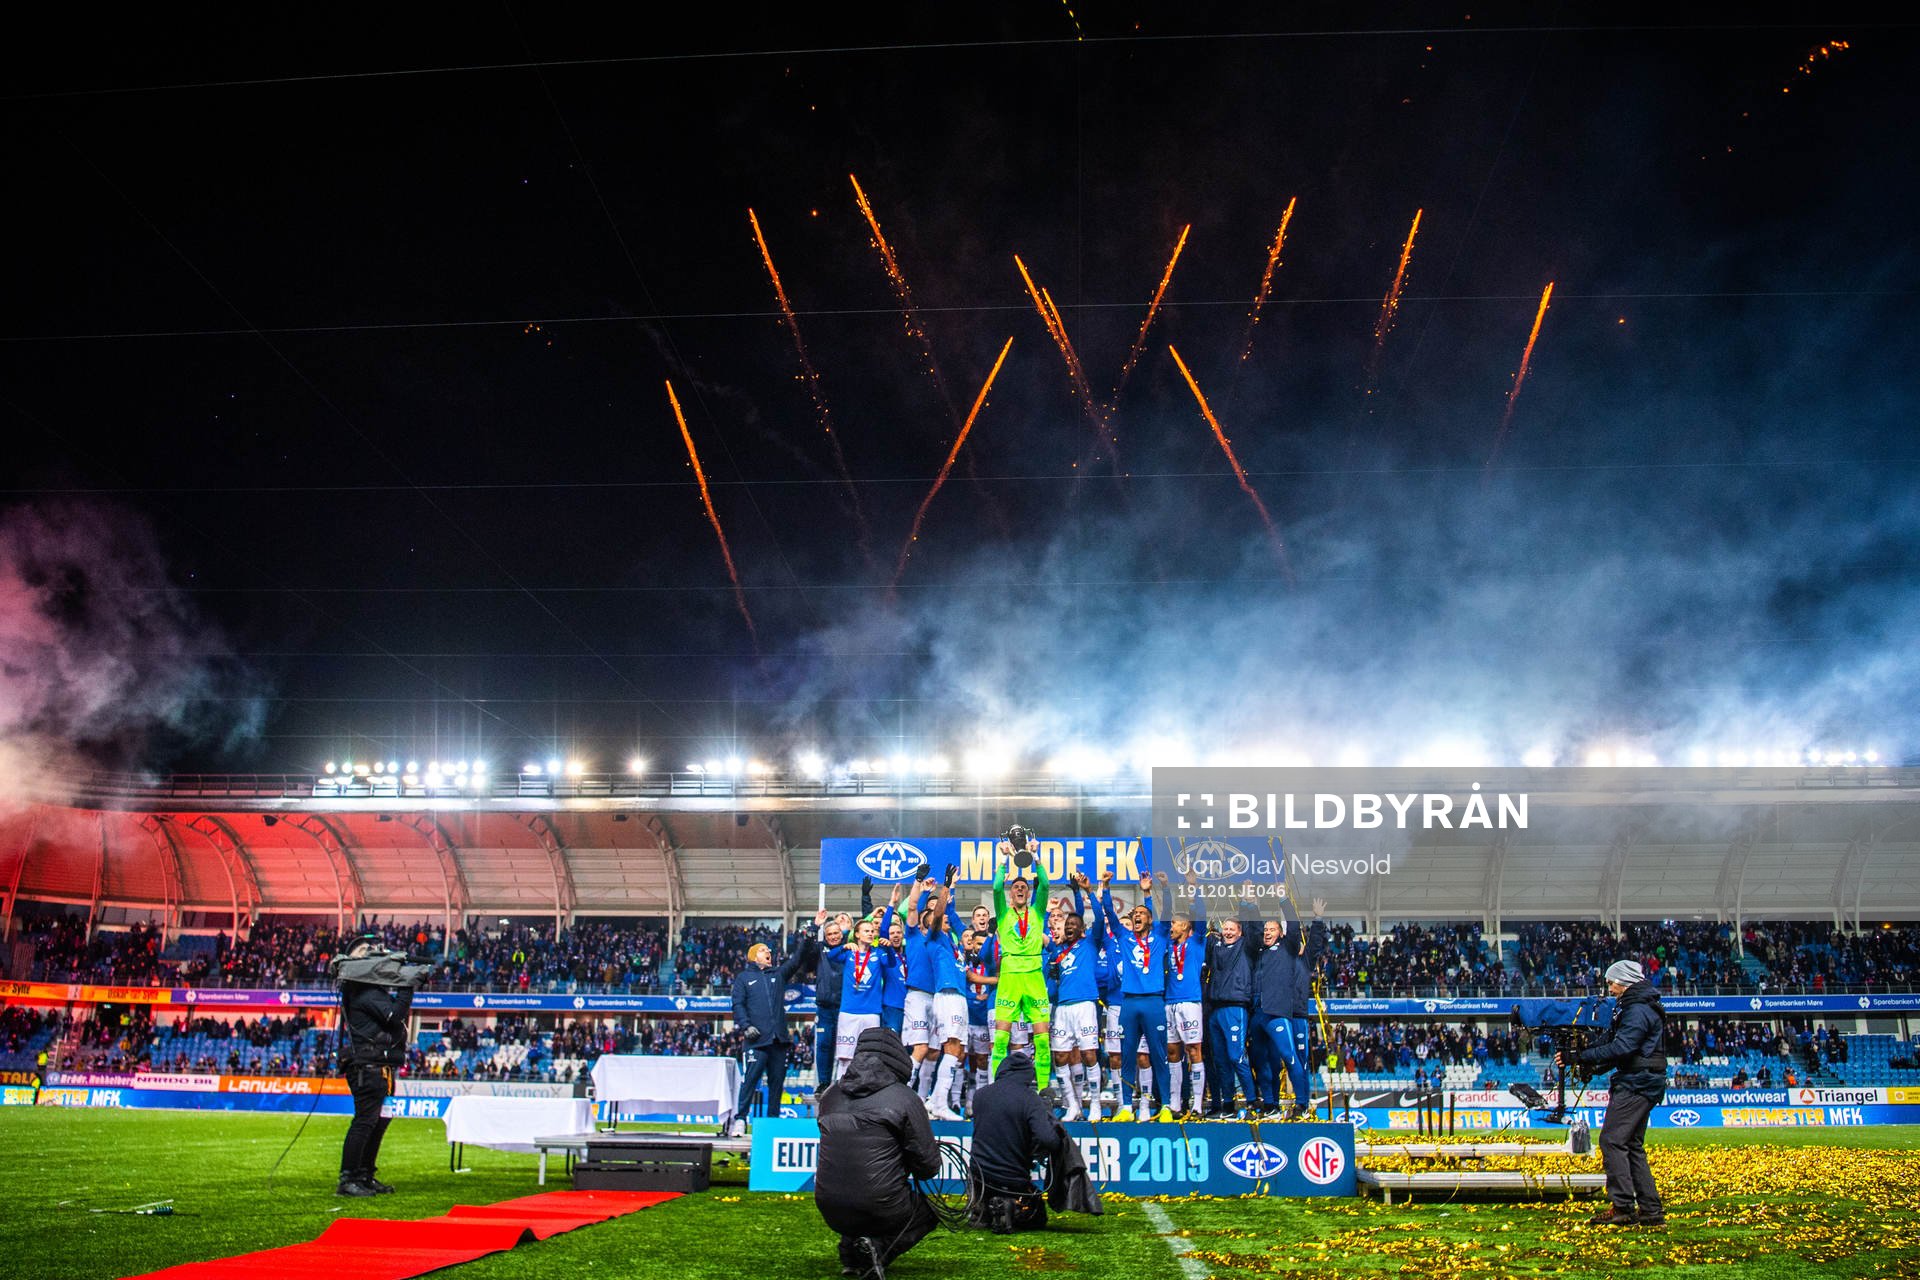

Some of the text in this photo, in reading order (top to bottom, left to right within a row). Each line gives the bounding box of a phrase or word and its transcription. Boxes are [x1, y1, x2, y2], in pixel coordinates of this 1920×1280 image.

[1096, 841, 1140, 881] FK
[91, 1089, 121, 1107] MFK
[402, 1083, 461, 1097] Vikenco
[491, 1085, 550, 1098] Vikenco
[1668, 1091, 1787, 1104] wenaas workwear
[1815, 1089, 1878, 1105] Triangel
[409, 1099, 439, 1117] MFK
[1721, 1107, 1864, 1126] SERIEMESTER MFK
[1129, 1137, 1209, 1182] 2019
